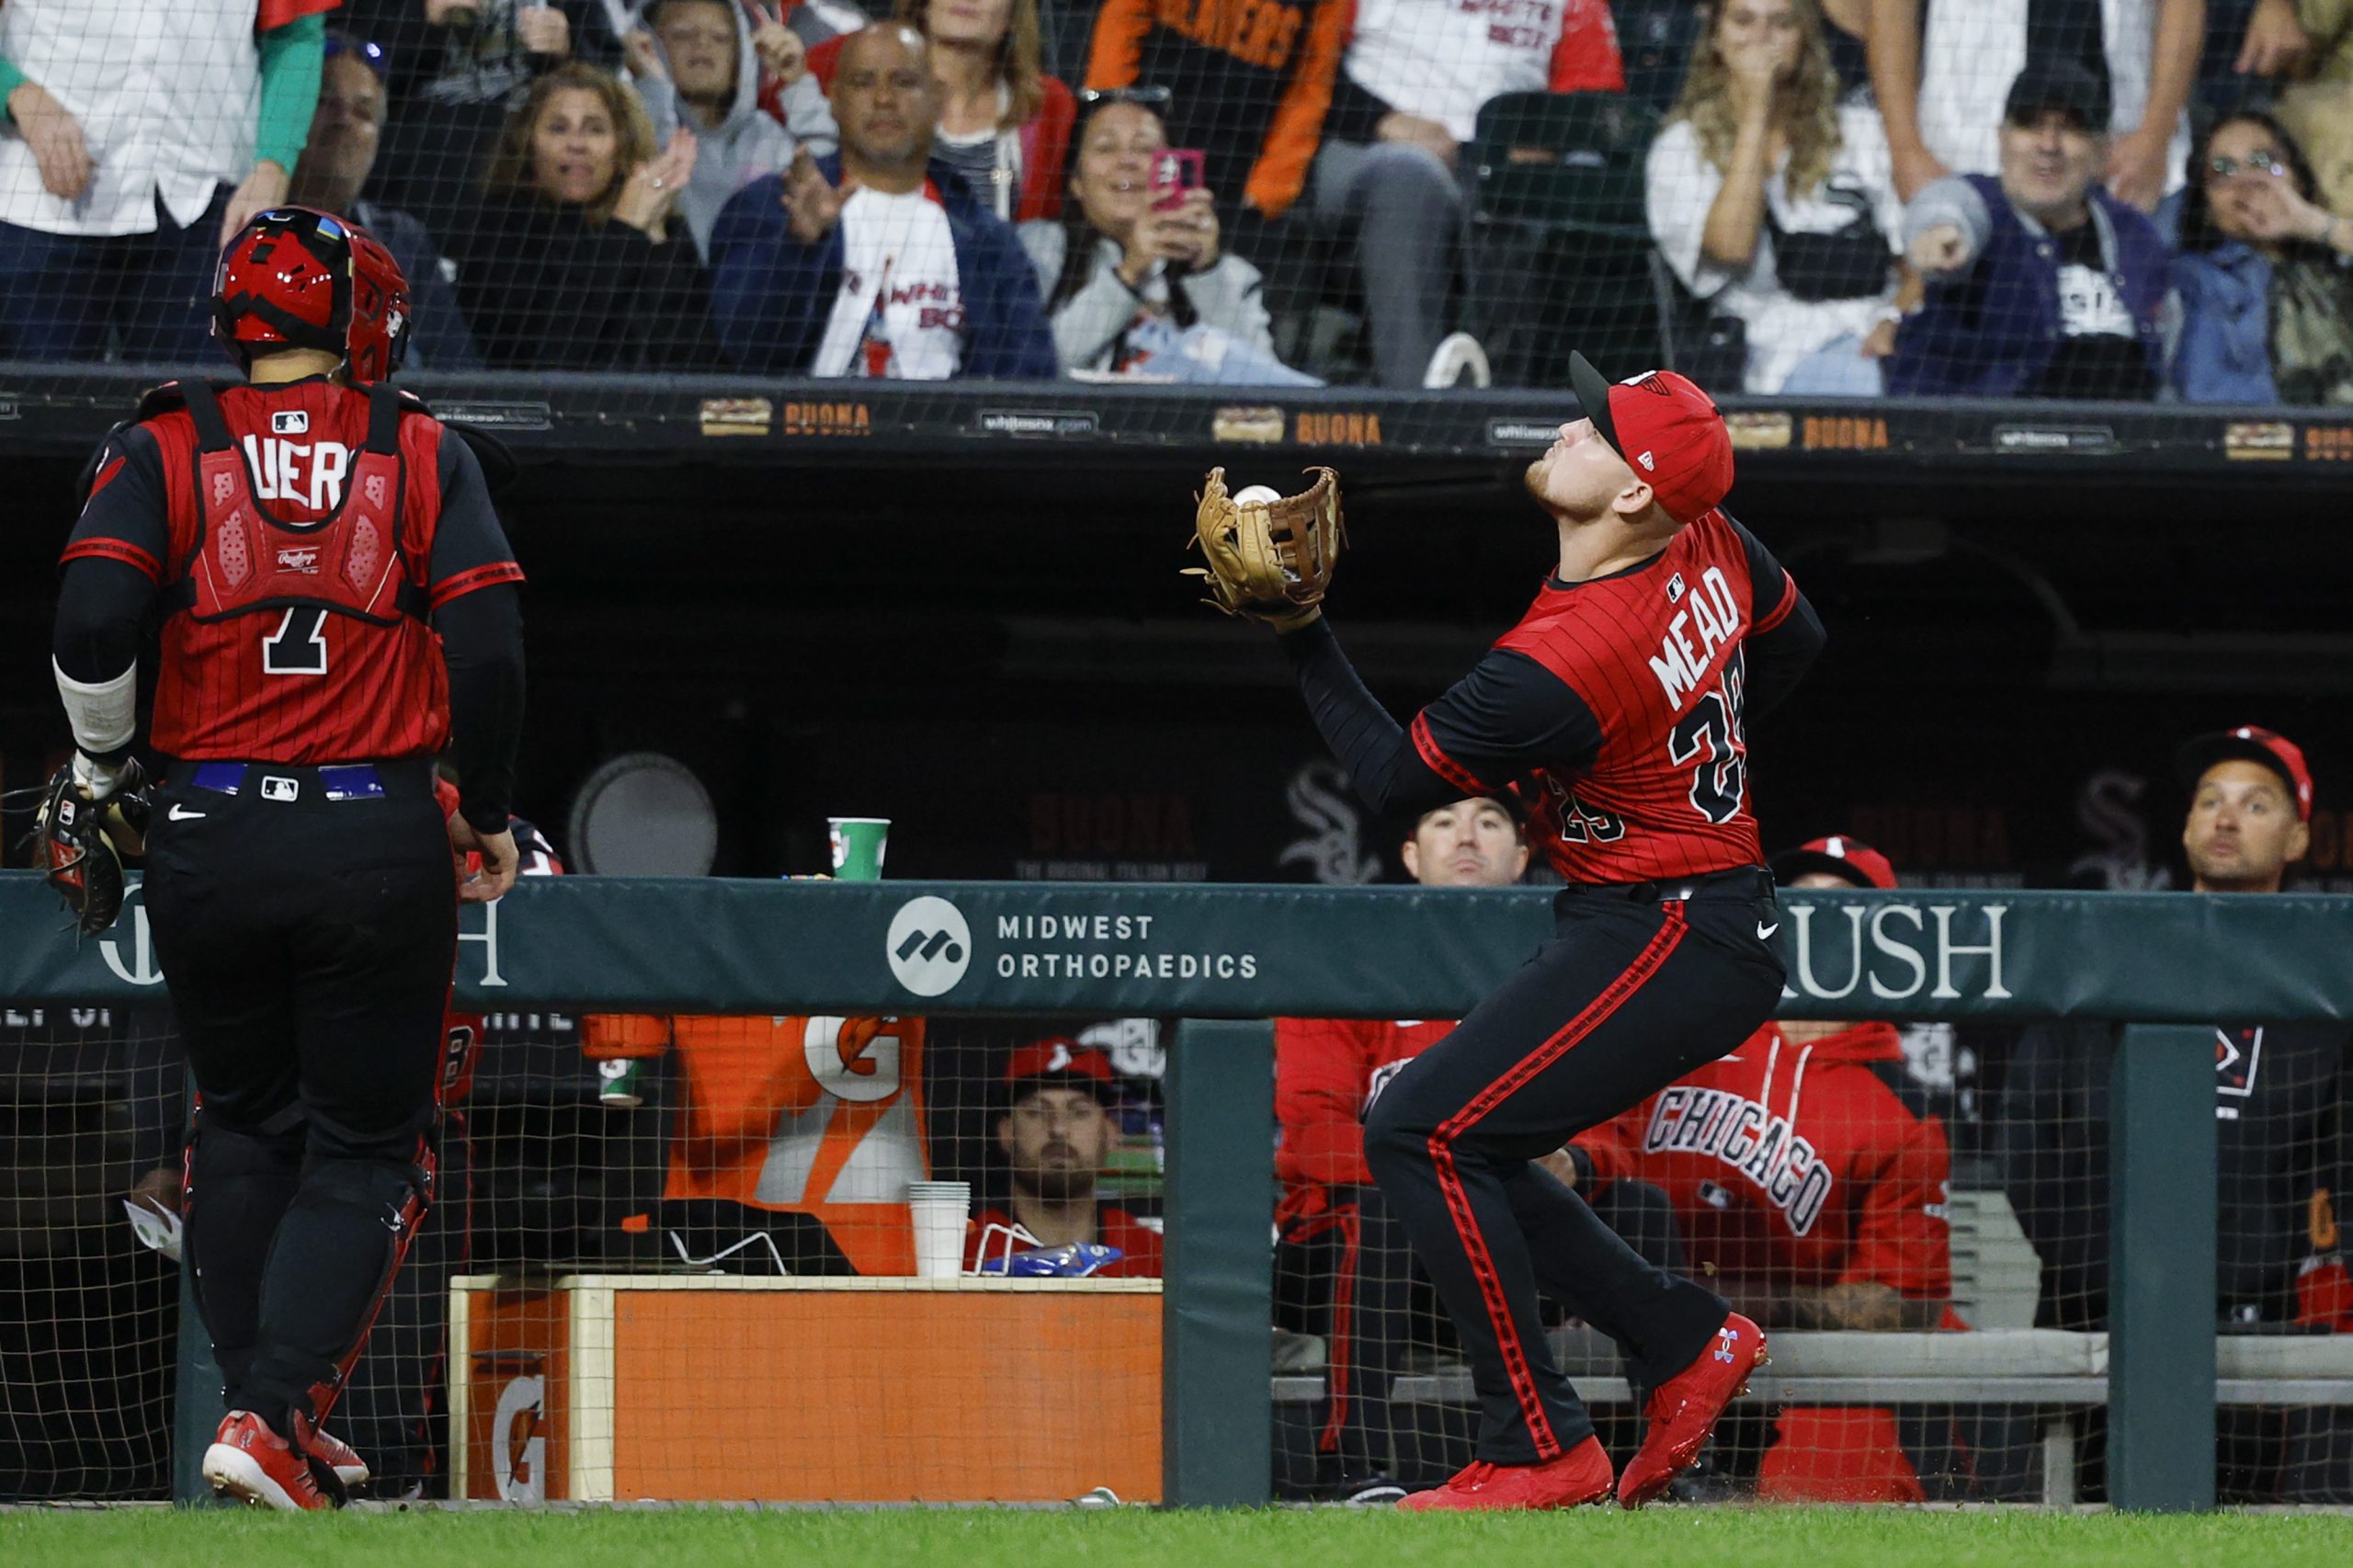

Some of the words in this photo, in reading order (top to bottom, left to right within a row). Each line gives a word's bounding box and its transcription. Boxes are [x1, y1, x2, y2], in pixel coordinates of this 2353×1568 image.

[1295, 413, 1382, 445] BUONA
[243, 434, 357, 510] UER
[1648, 565, 1740, 712] MEAD
[997, 915, 1154, 940] MIDWEST
[997, 953, 1257, 980] ORTHOPAEDICS
[1781, 904, 2013, 999] USH
[1643, 1085, 1833, 1237] CHICAGO
[492, 1374, 545, 1507] G
